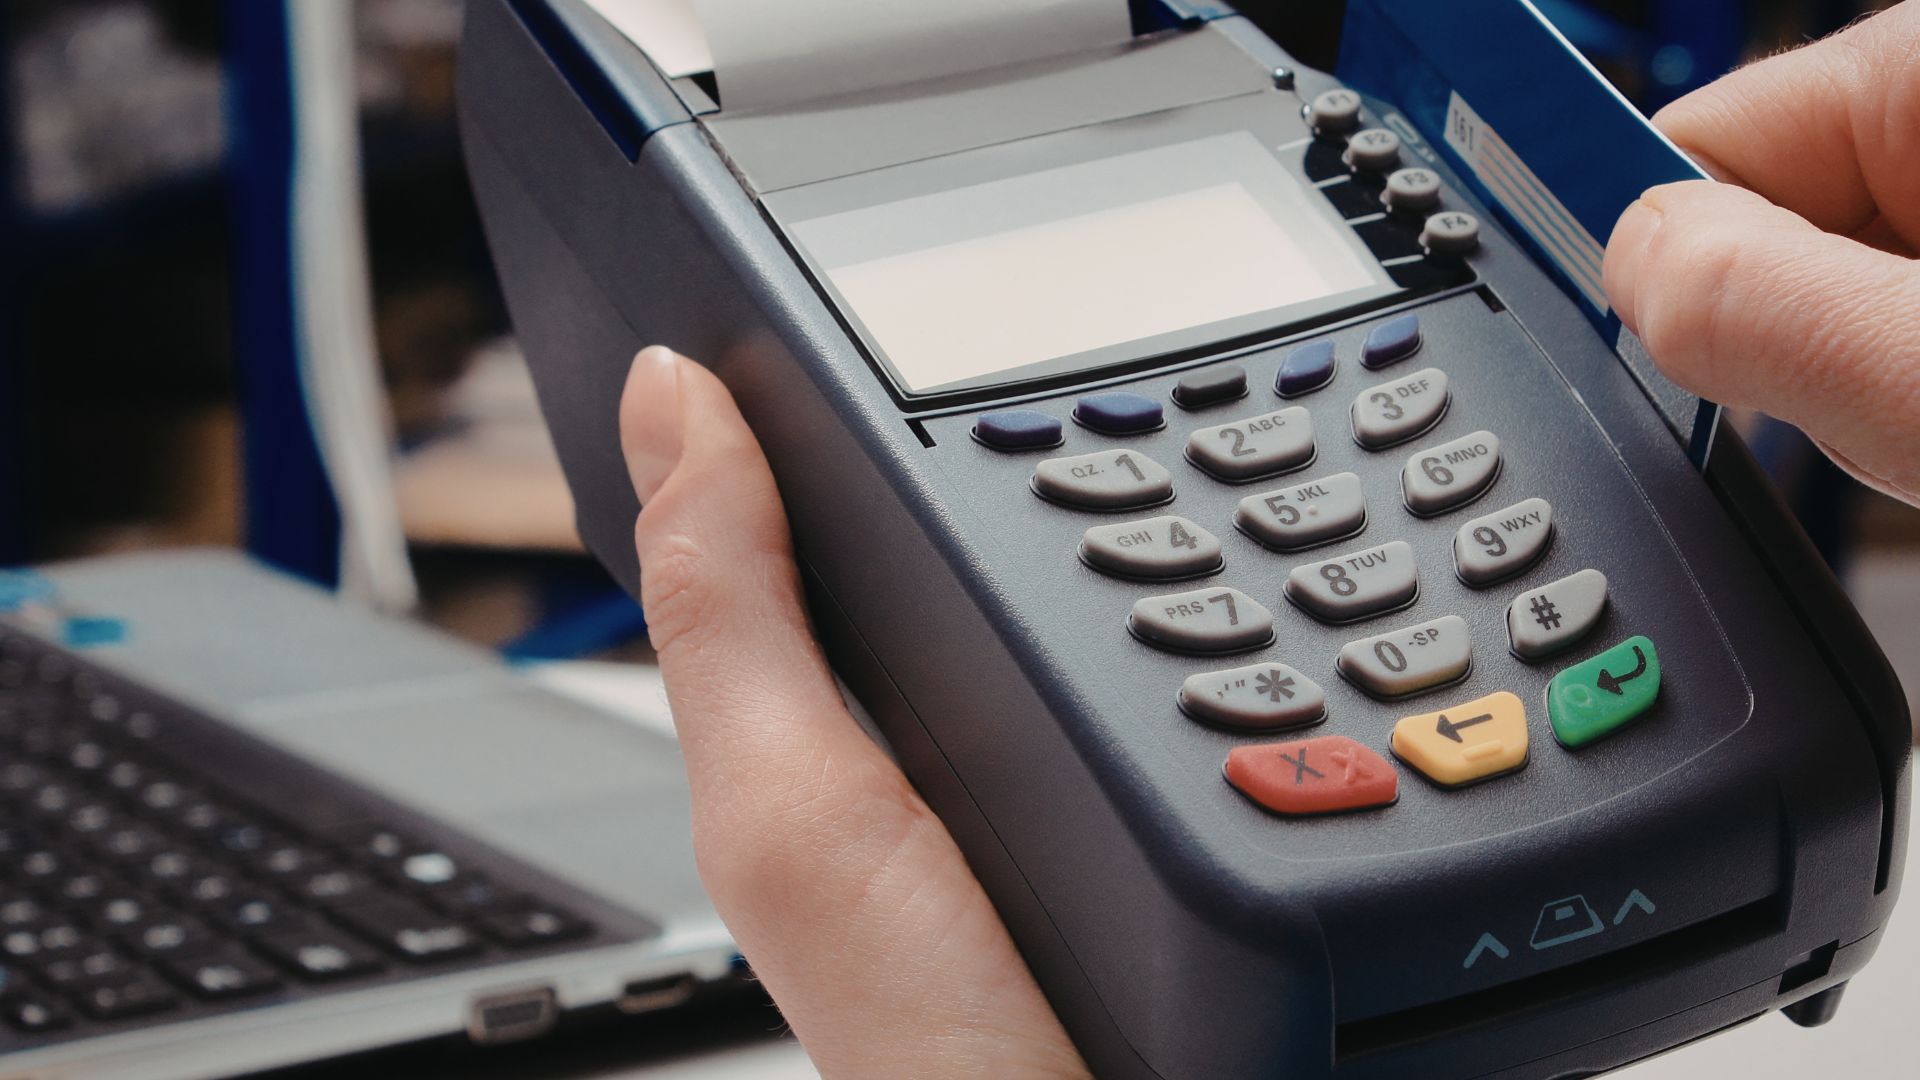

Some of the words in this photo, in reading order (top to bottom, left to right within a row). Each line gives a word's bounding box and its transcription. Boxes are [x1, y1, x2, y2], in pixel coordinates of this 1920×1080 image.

[1326, 93, 1352, 106] F1
[1363, 132, 1389, 145] F2
[1402, 171, 1429, 186] F3
[1441, 214, 1468, 229] F4
[1370, 391, 1404, 421] 3
[1395, 379, 1430, 399] DEF
[1218, 427, 1257, 457] 2
[1248, 414, 1286, 435] ABC
[1114, 453, 1146, 482] 1
[1420, 456, 1454, 486] 6
[1444, 443, 1489, 465] MNO
[1264, 495, 1301, 526] 5
[1297, 484, 1330, 502] JKL
[1116, 530, 1153, 548] GHI
[1169, 521, 1197, 550] 4
[1472, 526, 1507, 557] 9
[1500, 511, 1543, 532] WXY
[1320, 563, 1358, 596] 8
[1346, 550, 1387, 571] TUV
[1164, 601, 1204, 619] PRS
[1207, 592, 1239, 626] 7
